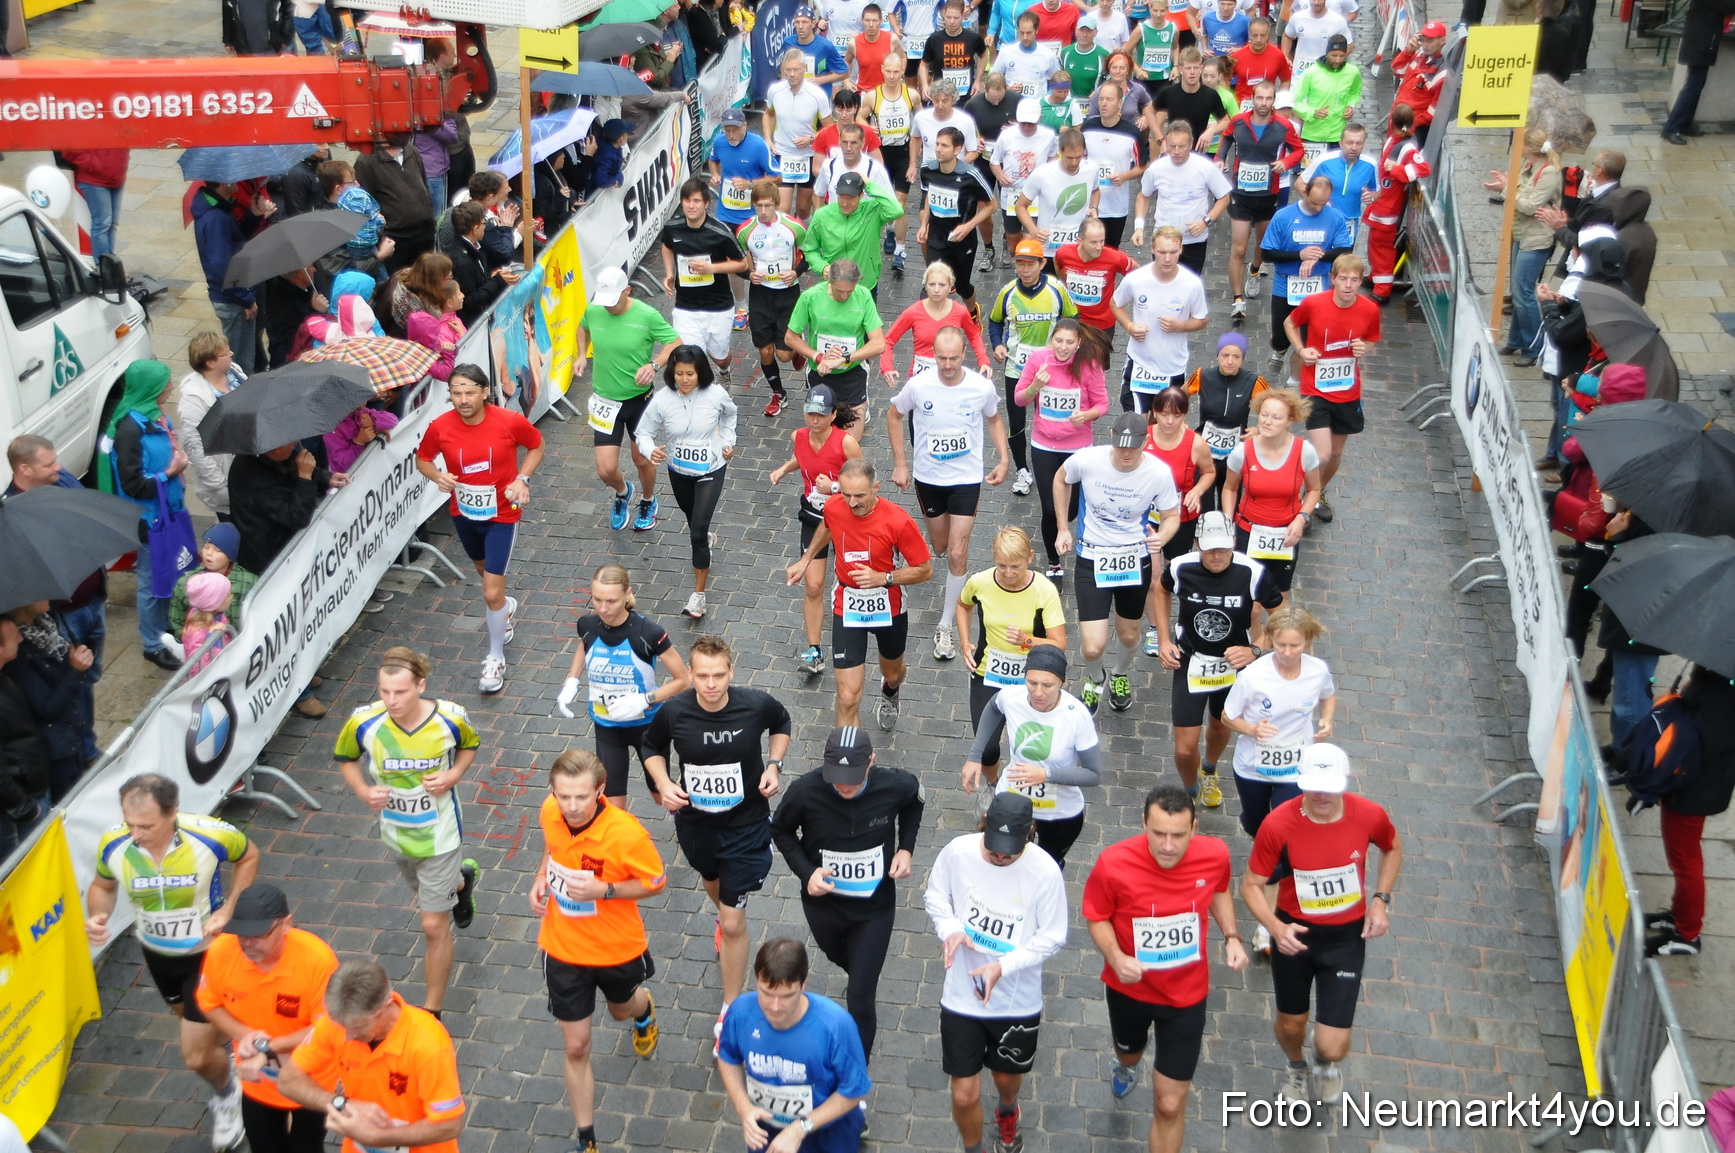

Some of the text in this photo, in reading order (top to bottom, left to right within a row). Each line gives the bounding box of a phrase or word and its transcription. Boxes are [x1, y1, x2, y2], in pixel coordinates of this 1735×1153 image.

[943, 42, 964, 55] RUN
[943, 57, 970, 68] FAST
[1467, 53, 1532, 76] Jugend-
[1482, 73, 1513, 88] lauf
[0, 92, 273, 121] celine: 09181 6352
[886, 118, 904, 129] 369
[783, 162, 807, 173] 2934
[1241, 171, 1266, 182] 2502
[727, 188, 745, 200] 406
[931, 193, 954, 208] 3141
[767, 263, 780, 274] 61
[1070, 282, 1098, 296] 2533
[1291, 281, 1319, 293] 2767
[1016, 313, 1052, 322] BOCK
[1320, 365, 1351, 380] 2310
[1043, 395, 1076, 410] 3123
[932, 437, 967, 453] 2598
[1205, 431, 1236, 448] 2263
[675, 446, 708, 462] 3068
[459, 491, 492, 507] 2287
[1258, 536, 1285, 551] 547
[245, 432, 421, 690] BMW EfficientDynam
[1100, 555, 1136, 571] 2468
[249, 652, 298, 723] Wenige
[356, 527, 384, 573] Mehr
[384, 474, 431, 537] Fahrfreu
[848, 597, 886, 613] 2288
[1200, 661, 1228, 677] 115
[1199, 677, 1225, 685] Michael
[703, 730, 733, 745] run
[383, 756, 441, 771] BOCK
[1261, 749, 1301, 766] 2891
[691, 777, 737, 794] 2480
[387, 795, 431, 813] 3076
[700, 798, 731, 806] Manfred
[829, 860, 875, 879] 3061
[132, 873, 199, 889] BOCK
[1310, 877, 1346, 897] 101
[1317, 897, 1344, 908] Jürgen
[968, 907, 1015, 940] 2401
[973, 934, 997, 948] Marco
[1141, 926, 1194, 949] 2296
[1157, 951, 1179, 961] Adolf
